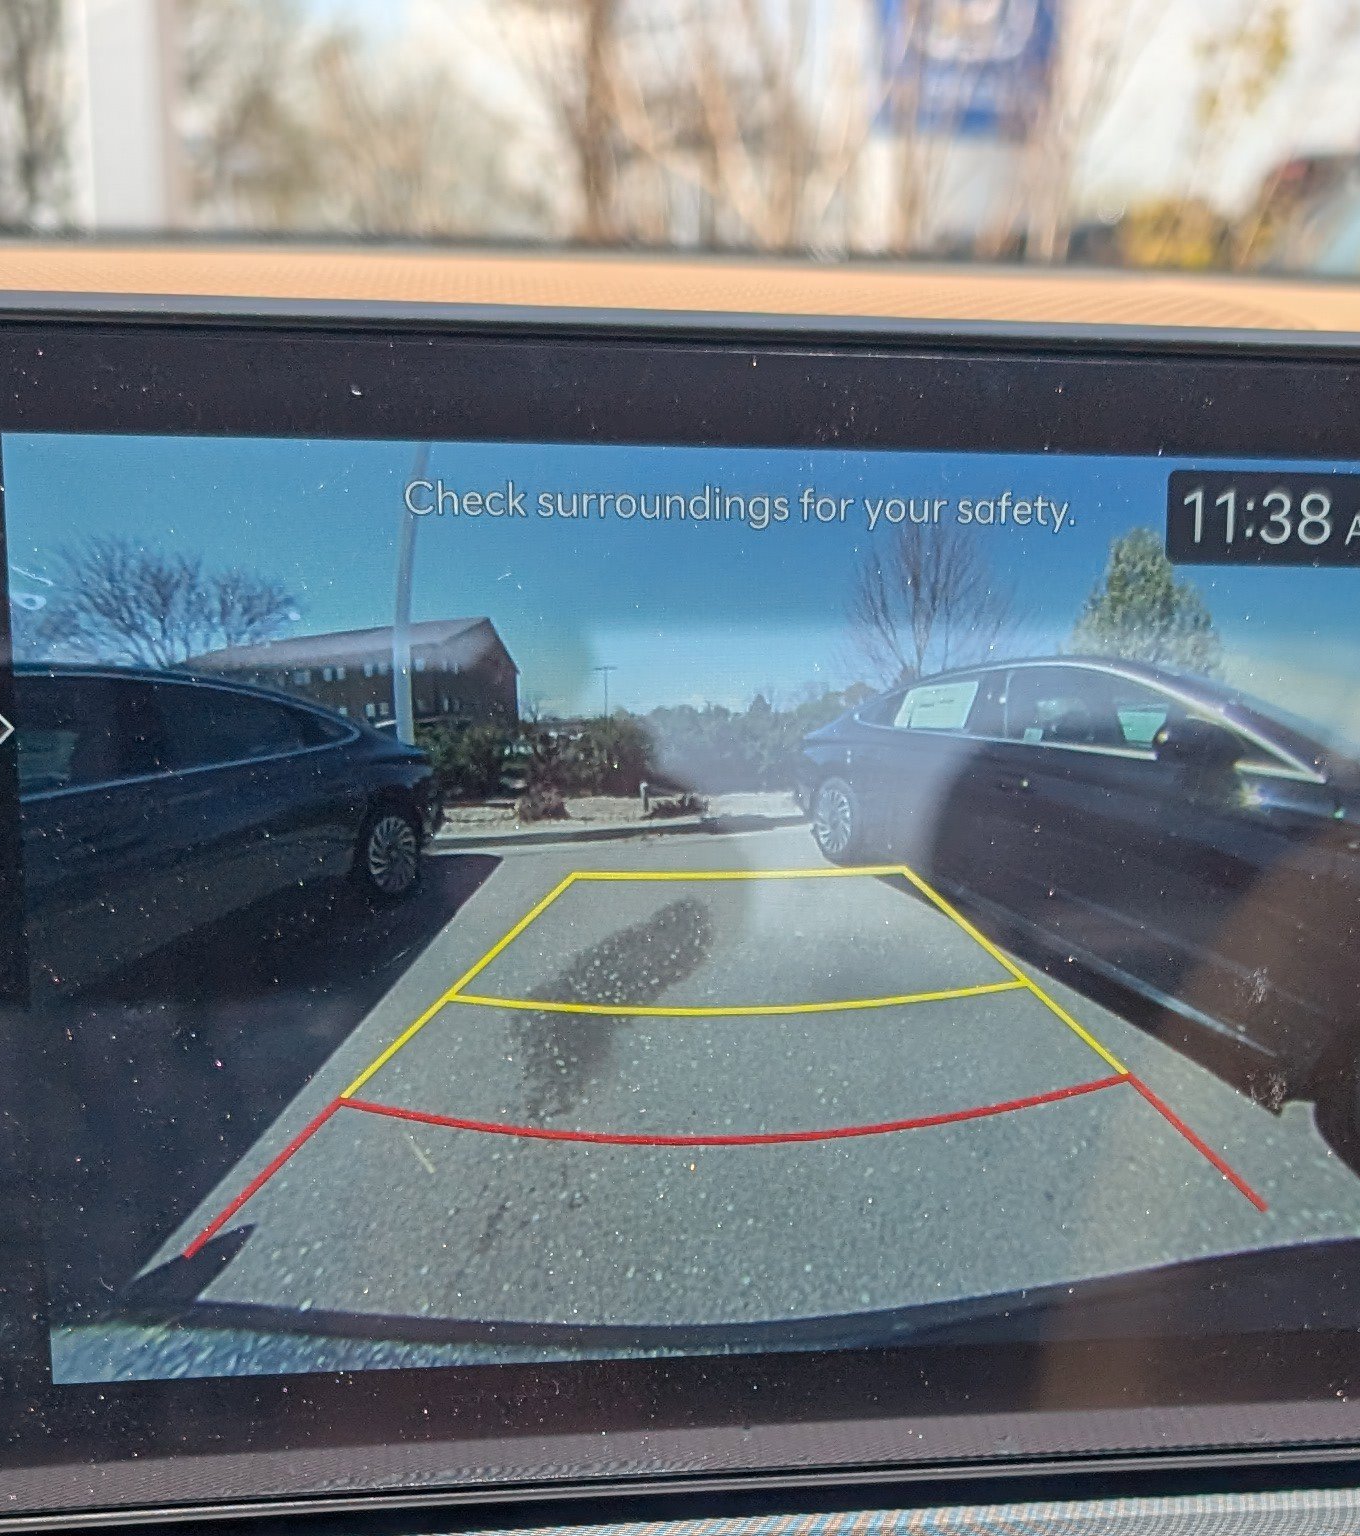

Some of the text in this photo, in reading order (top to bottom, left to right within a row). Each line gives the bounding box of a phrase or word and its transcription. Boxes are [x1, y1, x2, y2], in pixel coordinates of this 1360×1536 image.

[404, 479, 1077, 534] Check surroundings for your safety.
[1183, 490, 1332, 546] 11:38
